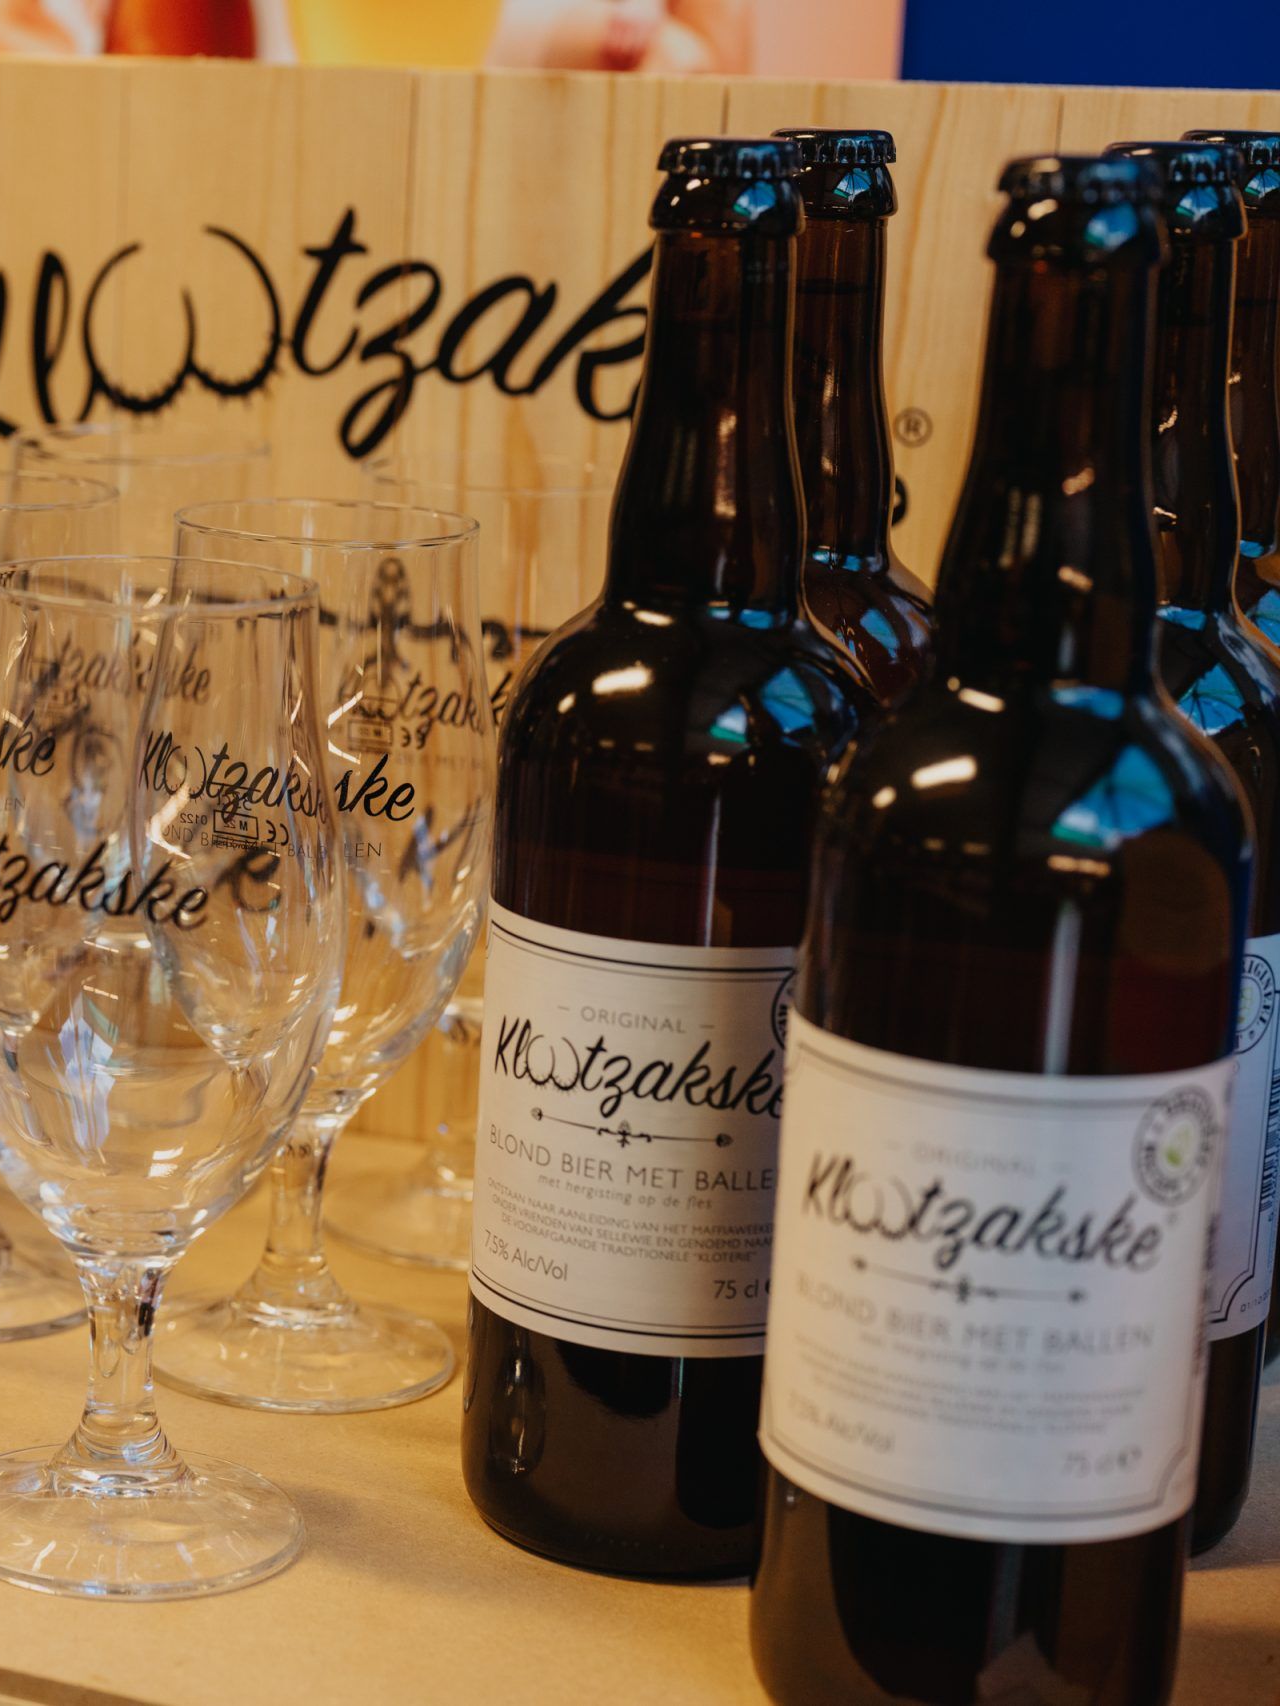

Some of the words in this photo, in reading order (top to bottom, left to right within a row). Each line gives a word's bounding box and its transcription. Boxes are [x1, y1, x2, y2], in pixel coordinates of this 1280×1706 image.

[580, 1005, 686, 1034] ORIGINAL
[489, 1124, 551, 1167] BLOND
[561, 1152, 614, 1183] BIER
[626, 1165, 683, 1190] MET
[695, 1169, 772, 1192] BALLE
[538, 1173, 560, 1188] met
[566, 1180, 632, 1206] hergisting
[638, 1195, 656, 1208] op
[663, 1193, 680, 1208] de
[633, 1220, 659, 1233] VAN
[663, 1224, 688, 1235] HET
[656, 1234, 673, 1248] EN
[678, 1237, 741, 1250] GENOEMD
[744, 1237, 774, 1248] NAA
[714, 1280, 737, 1299] 75
[743, 1279, 759, 1298] cl
